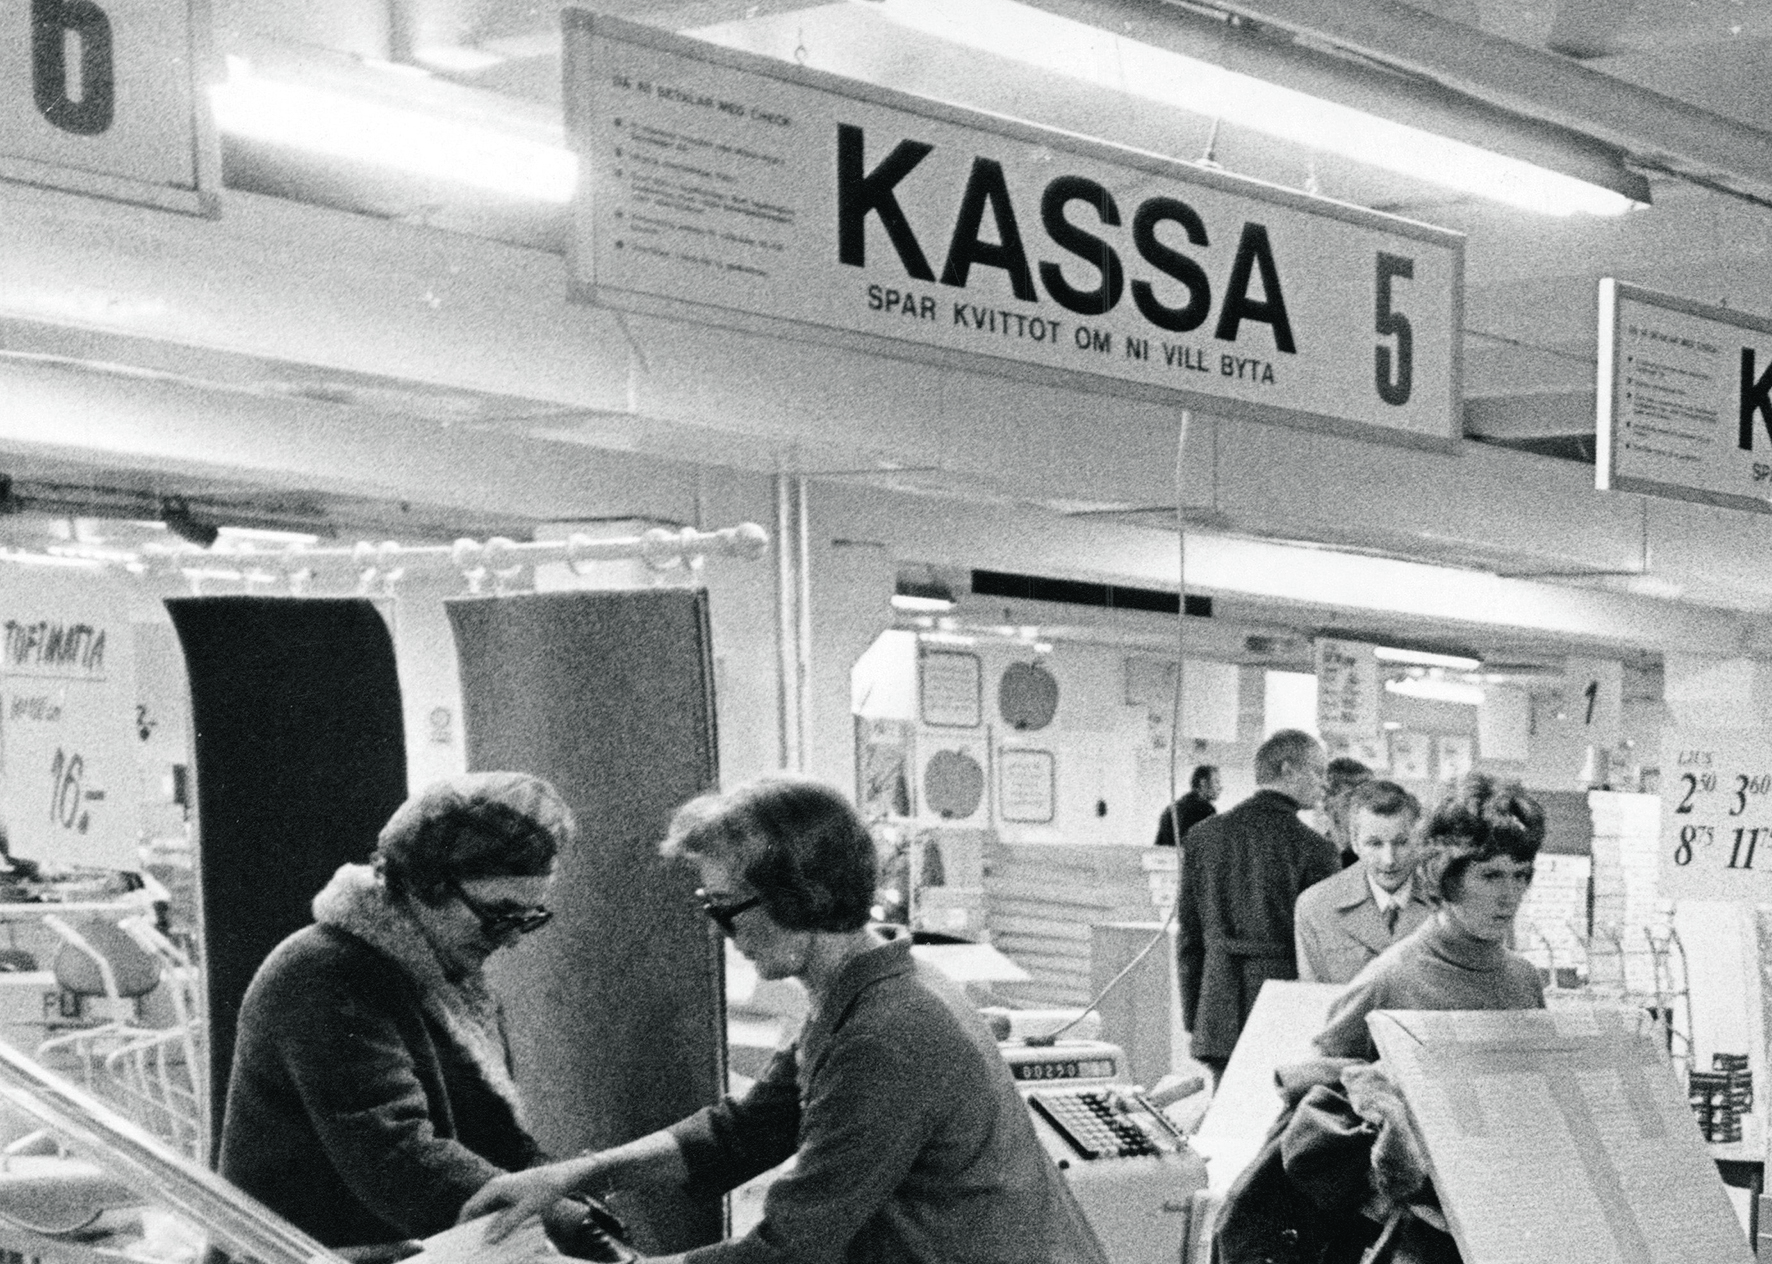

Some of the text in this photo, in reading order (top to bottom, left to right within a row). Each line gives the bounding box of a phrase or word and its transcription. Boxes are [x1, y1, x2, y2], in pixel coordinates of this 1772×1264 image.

[718, 100, 745, 117] MED
[751, 108, 791, 127] CHECK
[837, 122, 1297, 355] KASSA
[867, 284, 1275, 385] SPAR KVITTOT OM NI VILL BYTA
[1375, 251, 1414, 407] 5
